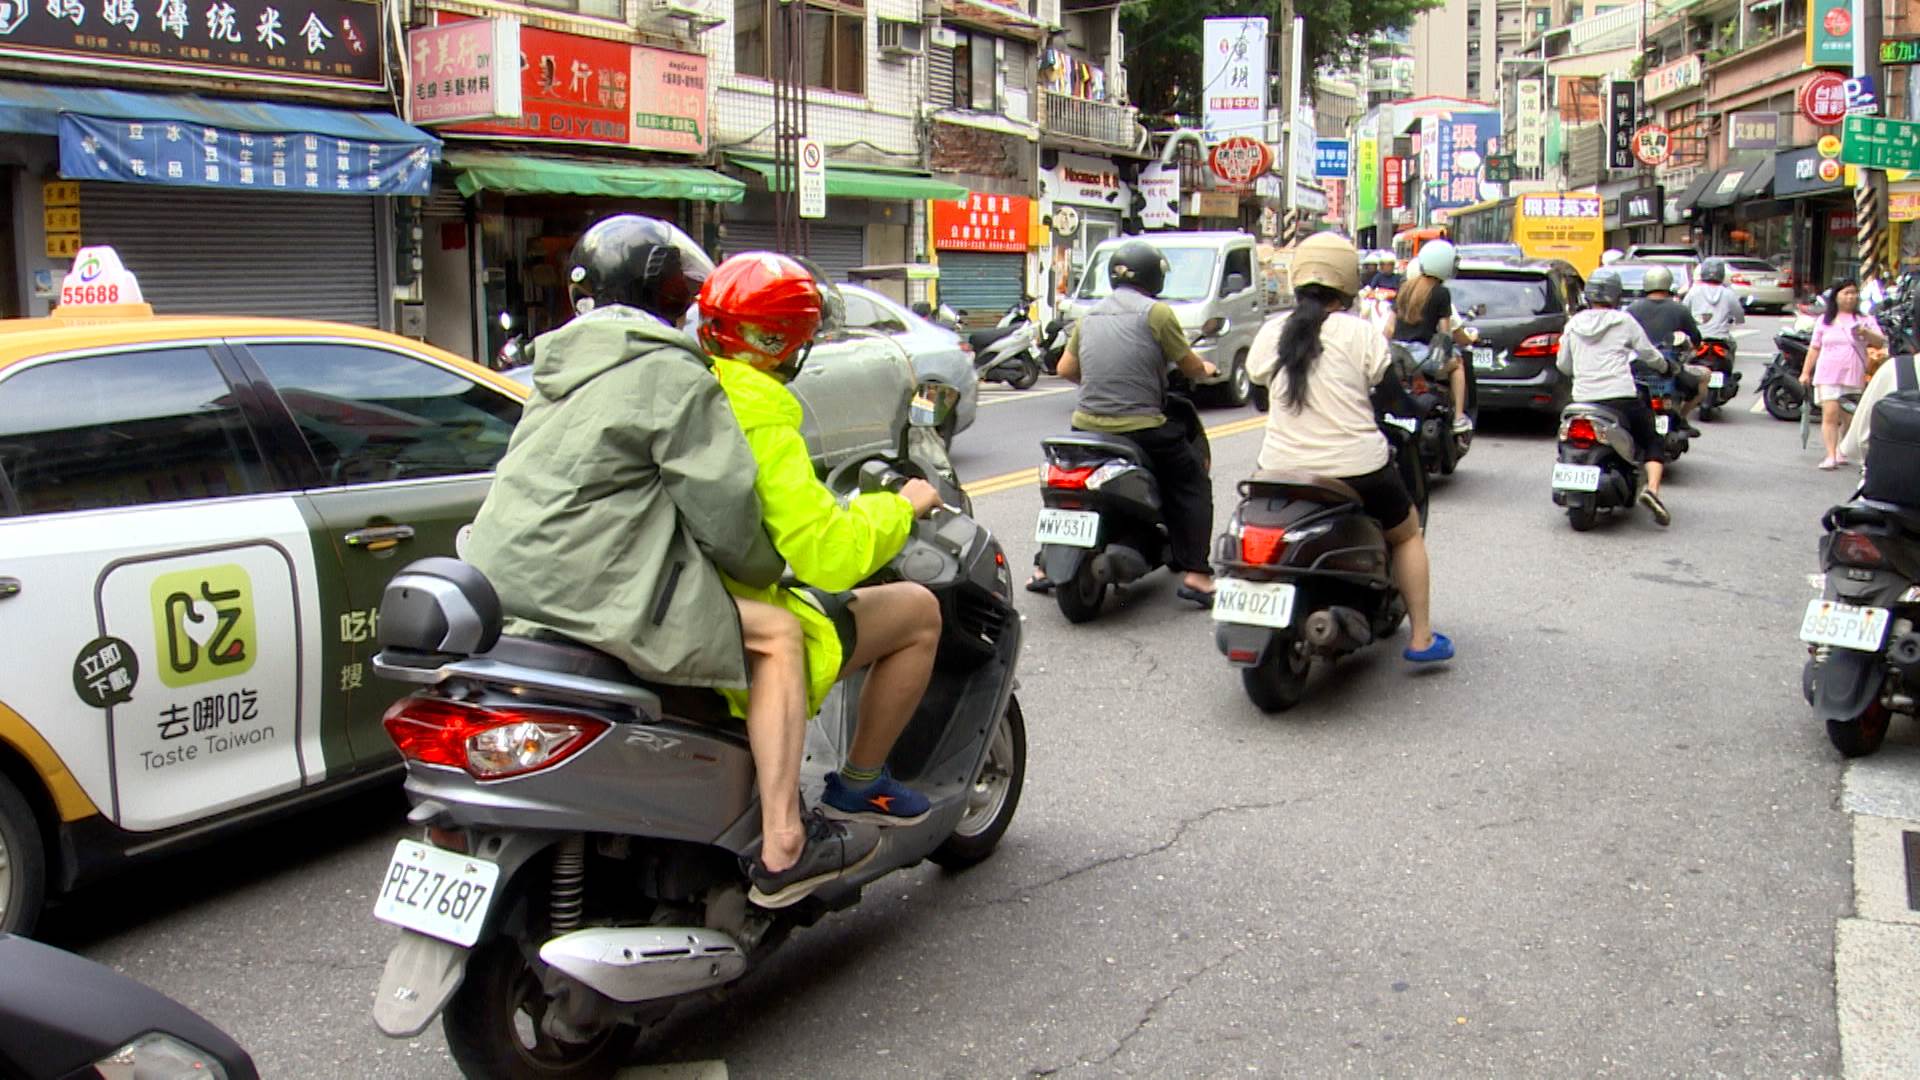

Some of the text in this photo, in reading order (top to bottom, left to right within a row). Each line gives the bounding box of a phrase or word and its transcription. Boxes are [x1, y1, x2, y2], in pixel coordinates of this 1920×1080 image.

[1843, 79, 1862, 108] P
[129, 123, 147, 177] 豆花
[1525, 198, 1599, 217] 飛哥英文
[63, 284, 119, 304] 55688
[81, 643, 123, 680] 立即
[157, 687, 260, 742] 去哪吃
[140, 725, 275, 772] Taste Taiwan
[383, 861, 488, 924] PEZ-7687
